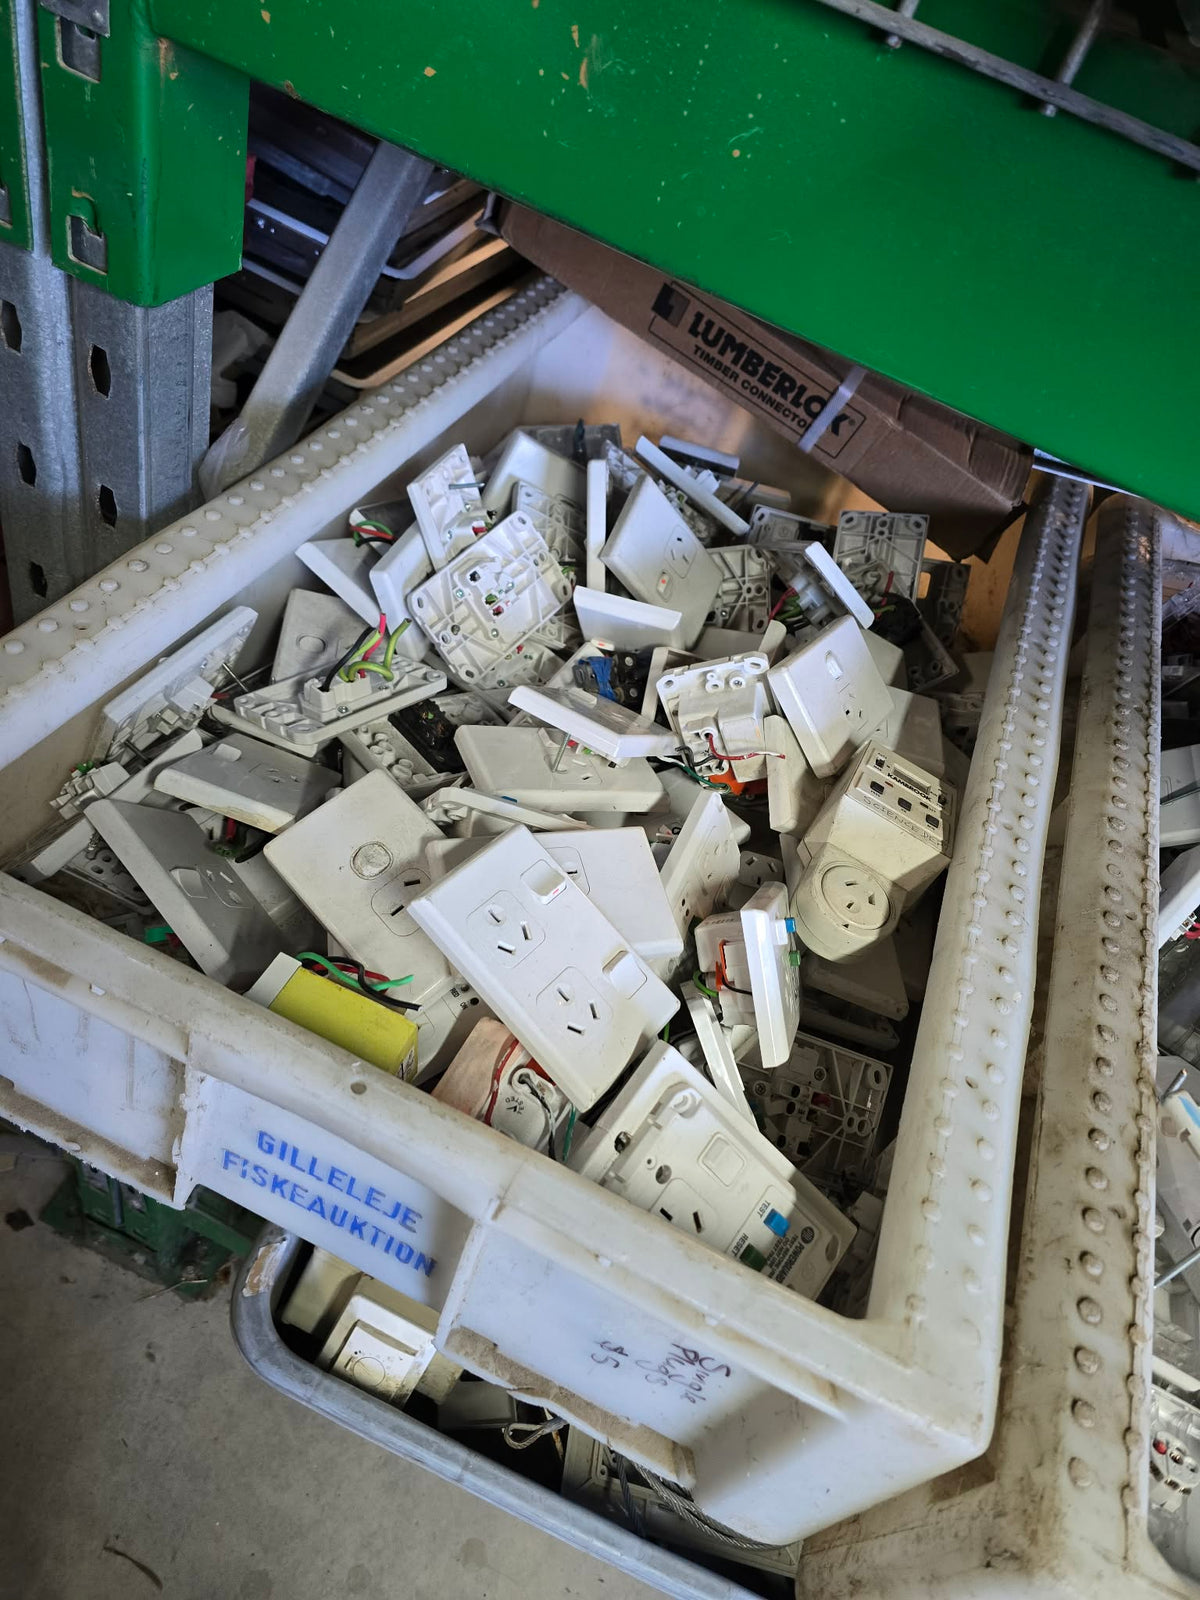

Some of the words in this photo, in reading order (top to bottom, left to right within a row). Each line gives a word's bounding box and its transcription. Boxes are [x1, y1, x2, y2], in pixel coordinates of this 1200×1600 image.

[693, 344, 739, 383] TIMBER
[741, 378, 813, 431] CONNECTO
[887, 772, 932, 802] KAMBROOK
[863, 796, 919, 833] SCIENCE
[257, 1129, 423, 1234] GILLELEJE
[221, 1149, 437, 1278] FISKEAUKTION
[757, 1200, 771, 1218] TEST
[731, 1232, 749, 1257] RESET
